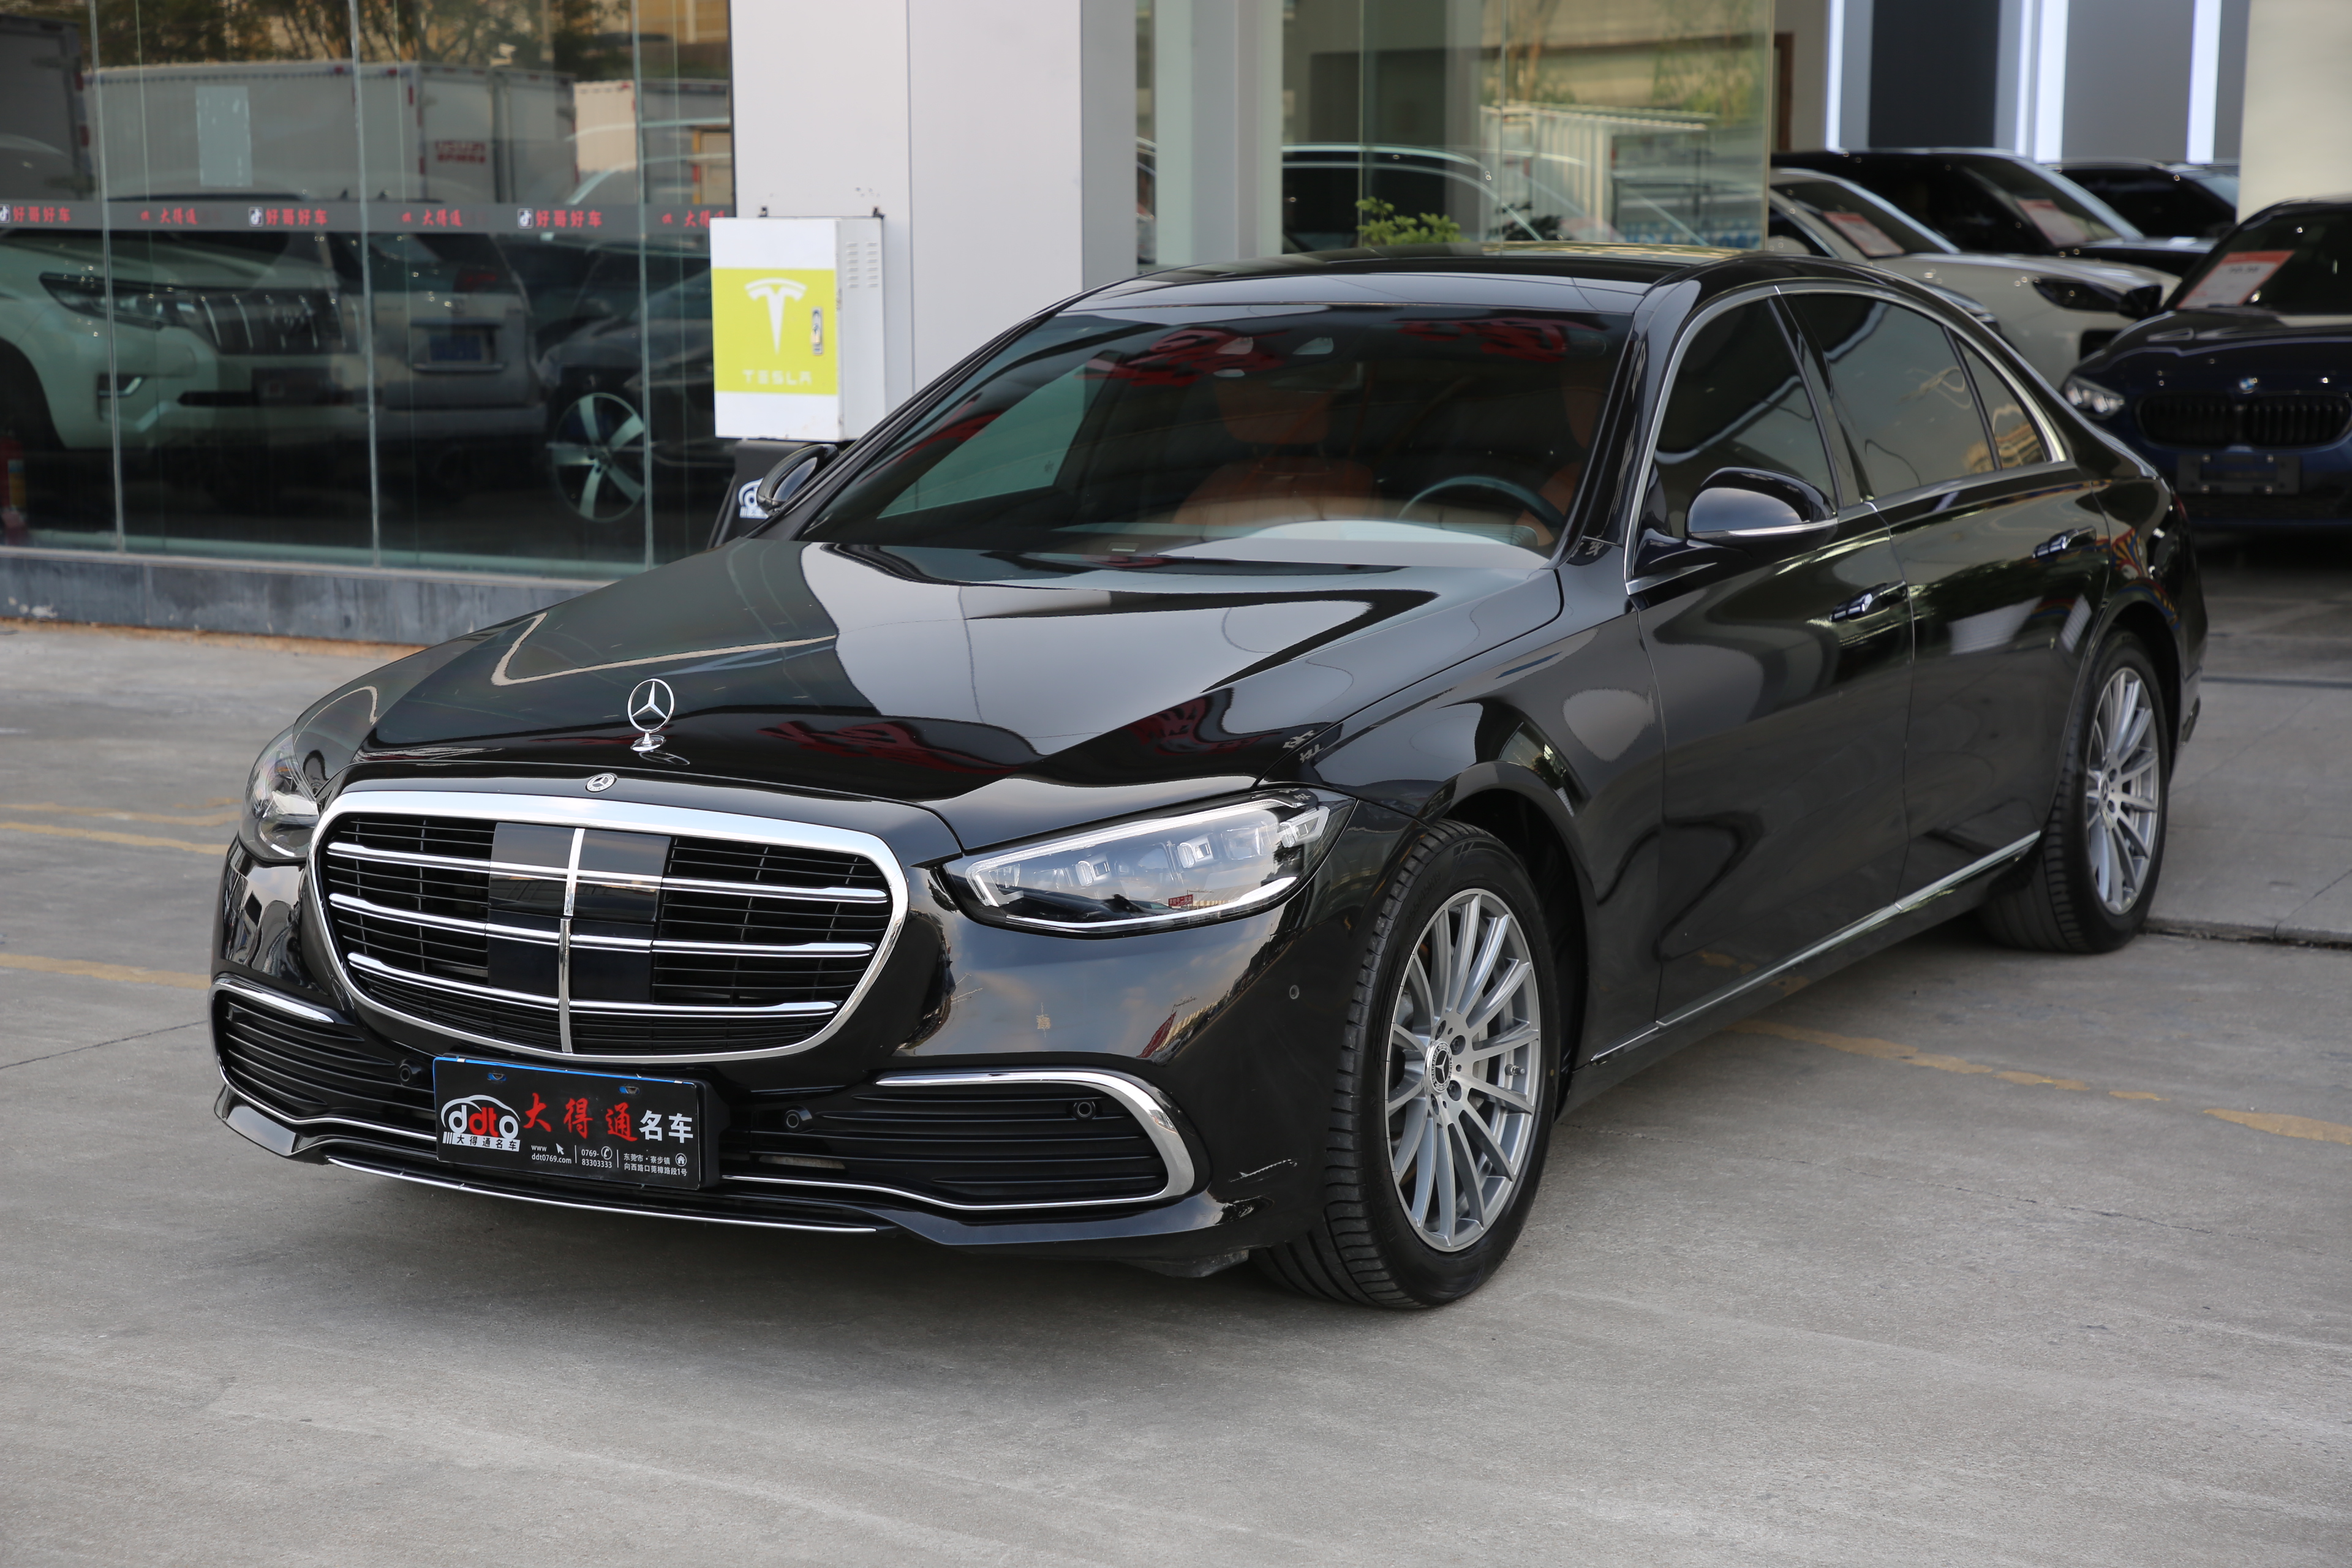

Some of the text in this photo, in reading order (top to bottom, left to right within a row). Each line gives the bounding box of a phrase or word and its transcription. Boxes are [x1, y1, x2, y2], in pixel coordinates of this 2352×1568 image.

[13, 206, 71, 223] 好哥好车
[160, 208, 198, 225] 大得通
[265, 208, 328, 226] 好哥好车
[423, 209, 463, 227] 大得通
[535, 210, 603, 228] 好哥好车
[742, 369, 813, 385] TESLA
[456, 1134, 517, 1150] 大得通名车
[532, 1153, 572, 1164] ddt0769.com
[582, 1158, 612, 1169] 83303333
